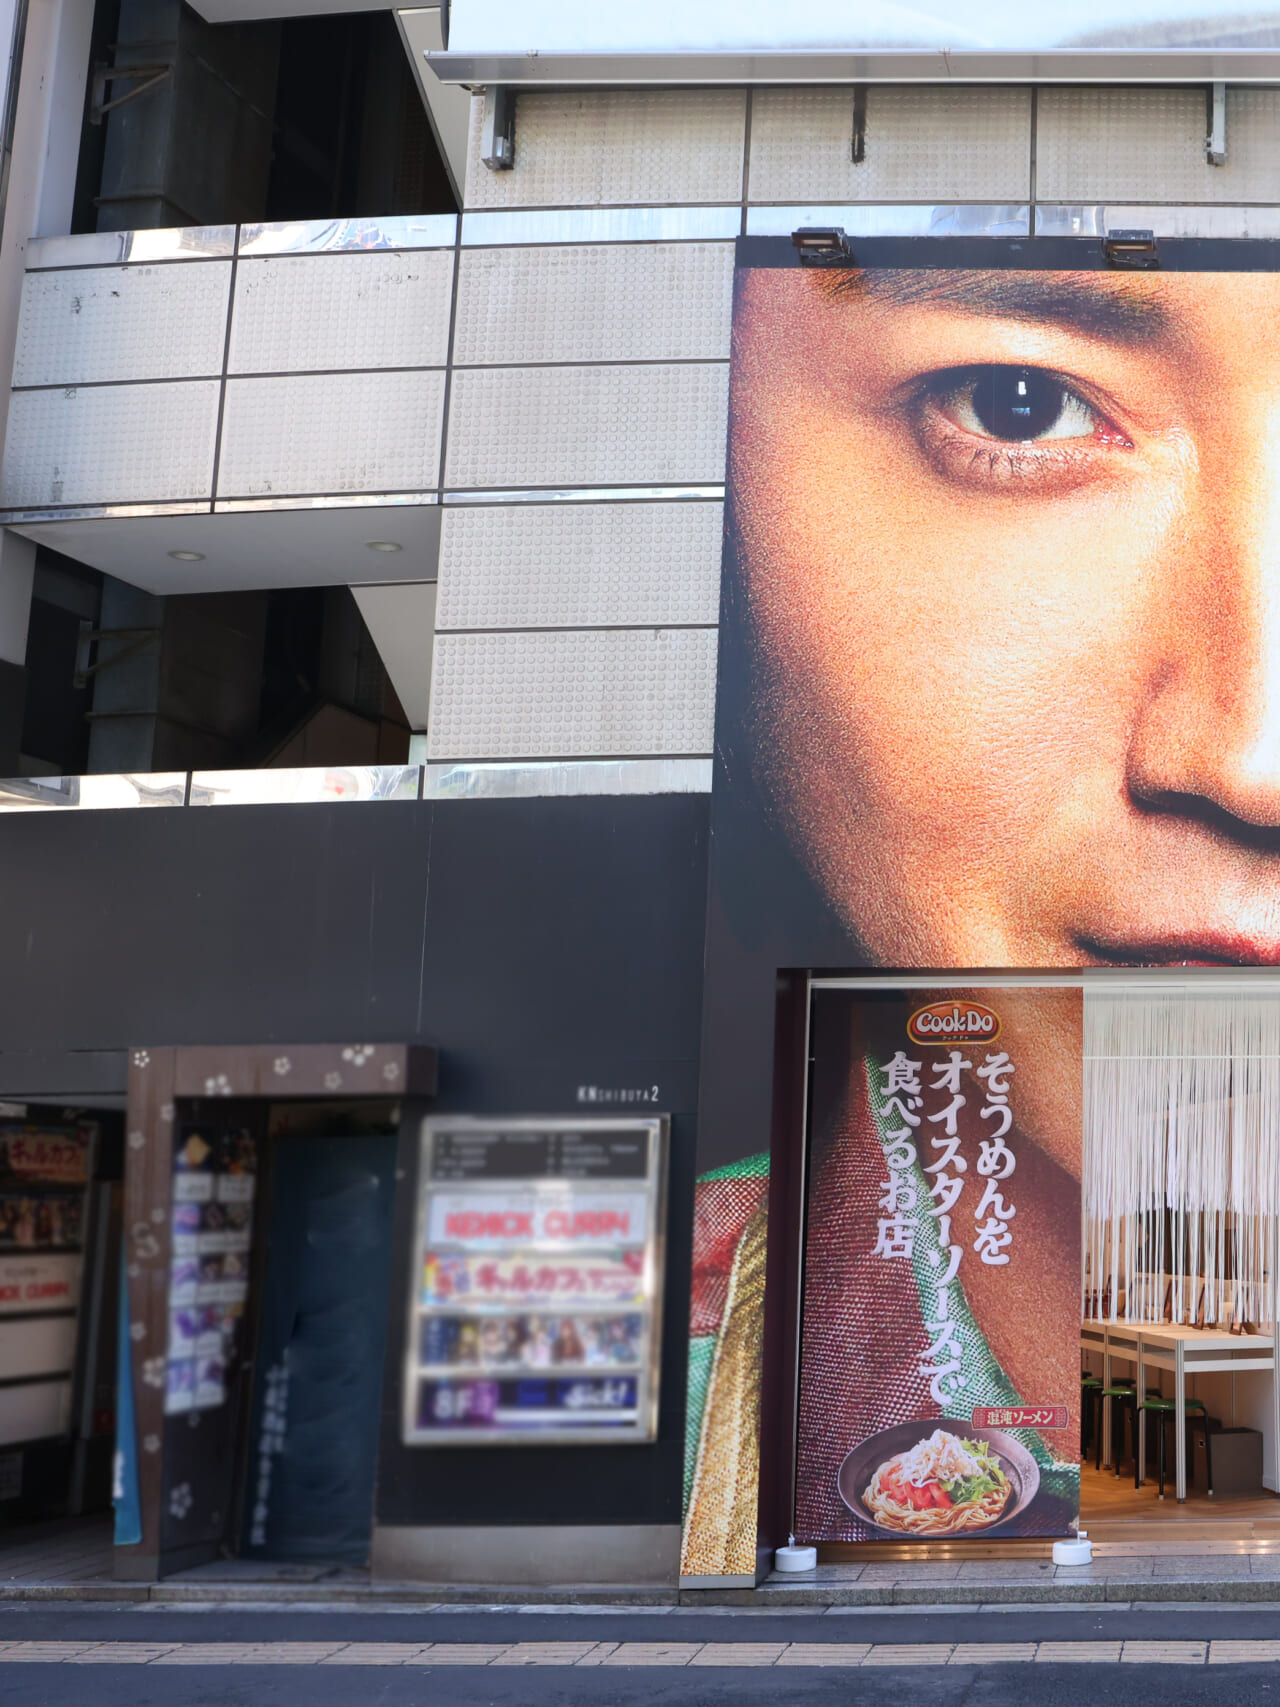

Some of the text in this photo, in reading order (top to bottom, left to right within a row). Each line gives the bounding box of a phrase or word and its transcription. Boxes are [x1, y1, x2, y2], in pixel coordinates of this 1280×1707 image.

[870, 1050, 923, 1260] 食べるお店
[917, 1050, 973, 1407] オイスターソースで
[973, 1051, 1016, 1266] そうめんを
